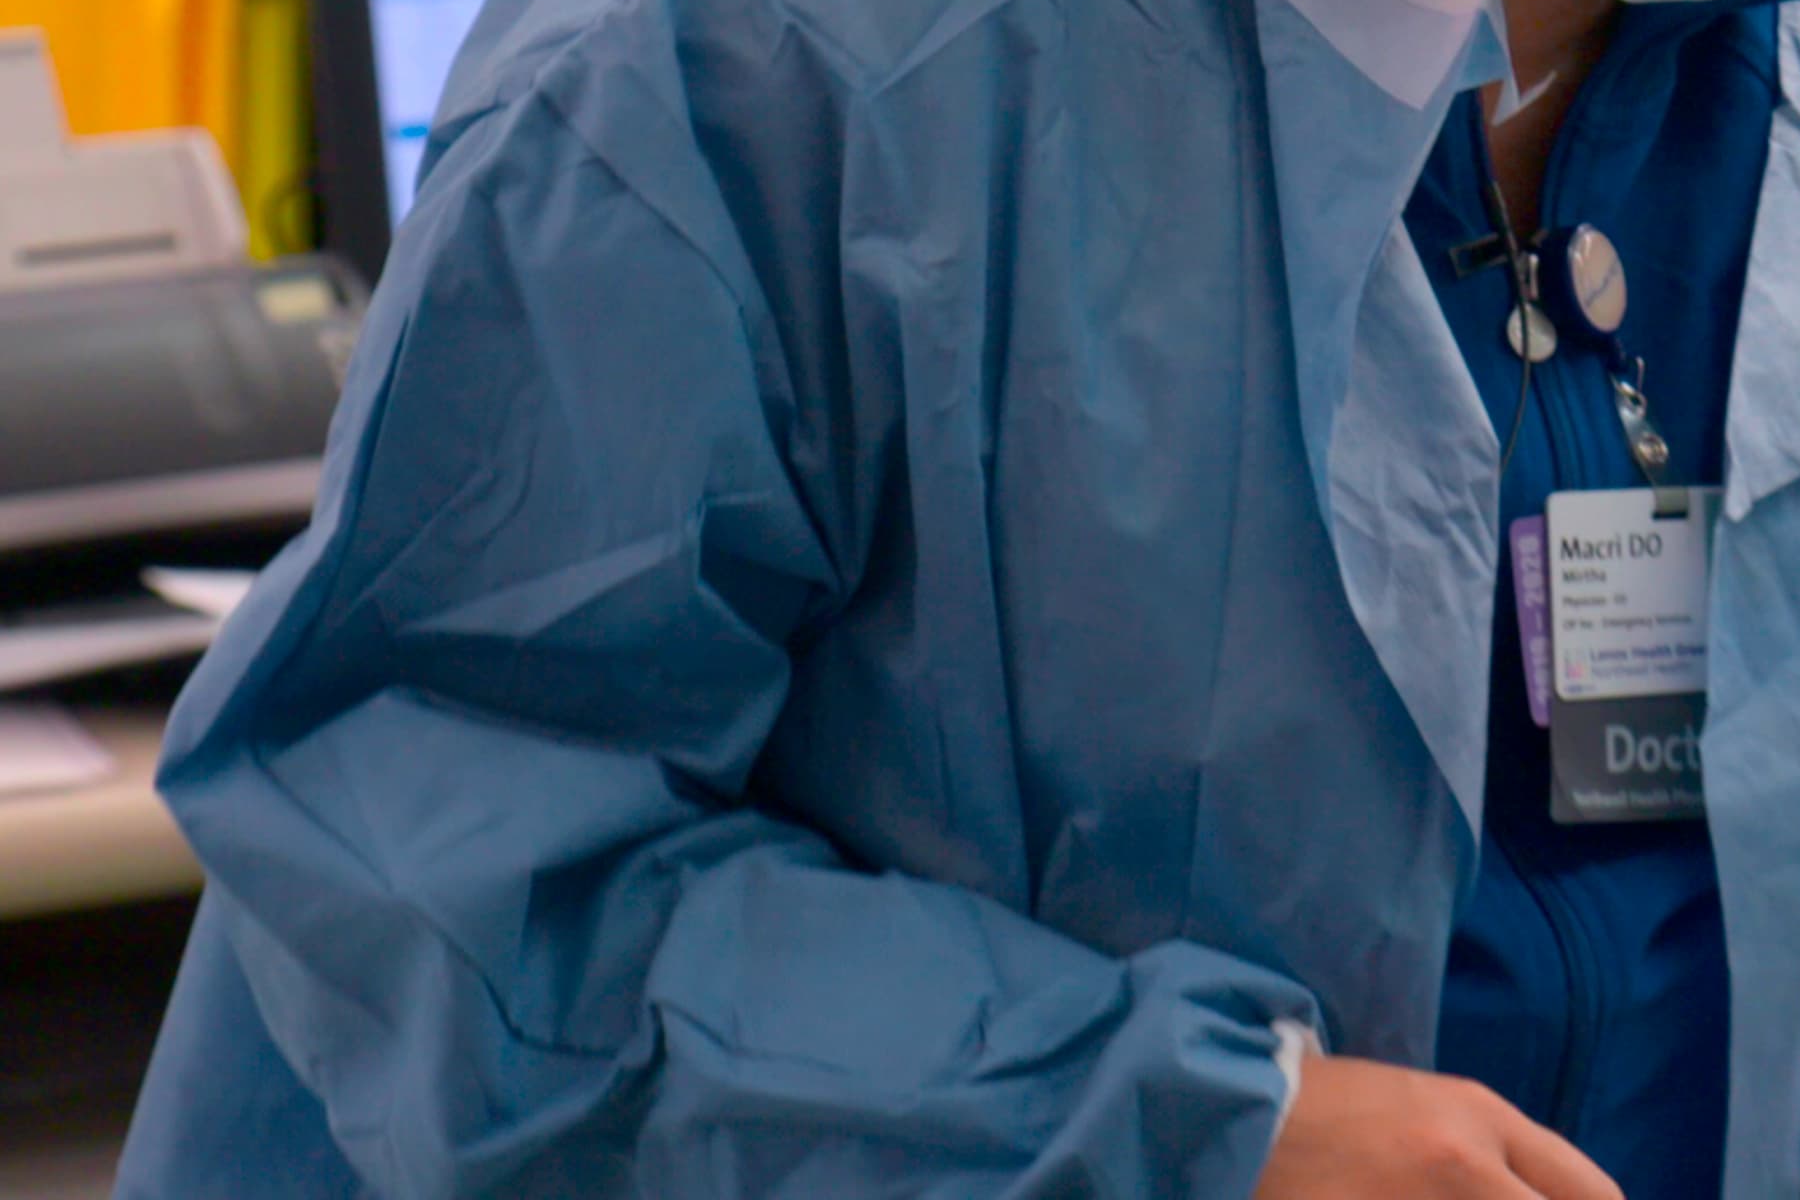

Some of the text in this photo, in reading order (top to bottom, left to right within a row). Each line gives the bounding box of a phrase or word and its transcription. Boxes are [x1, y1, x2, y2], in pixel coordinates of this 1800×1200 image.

[1560, 533, 1662, 560] Macri DO
[1606, 723, 1701, 773] Doct
